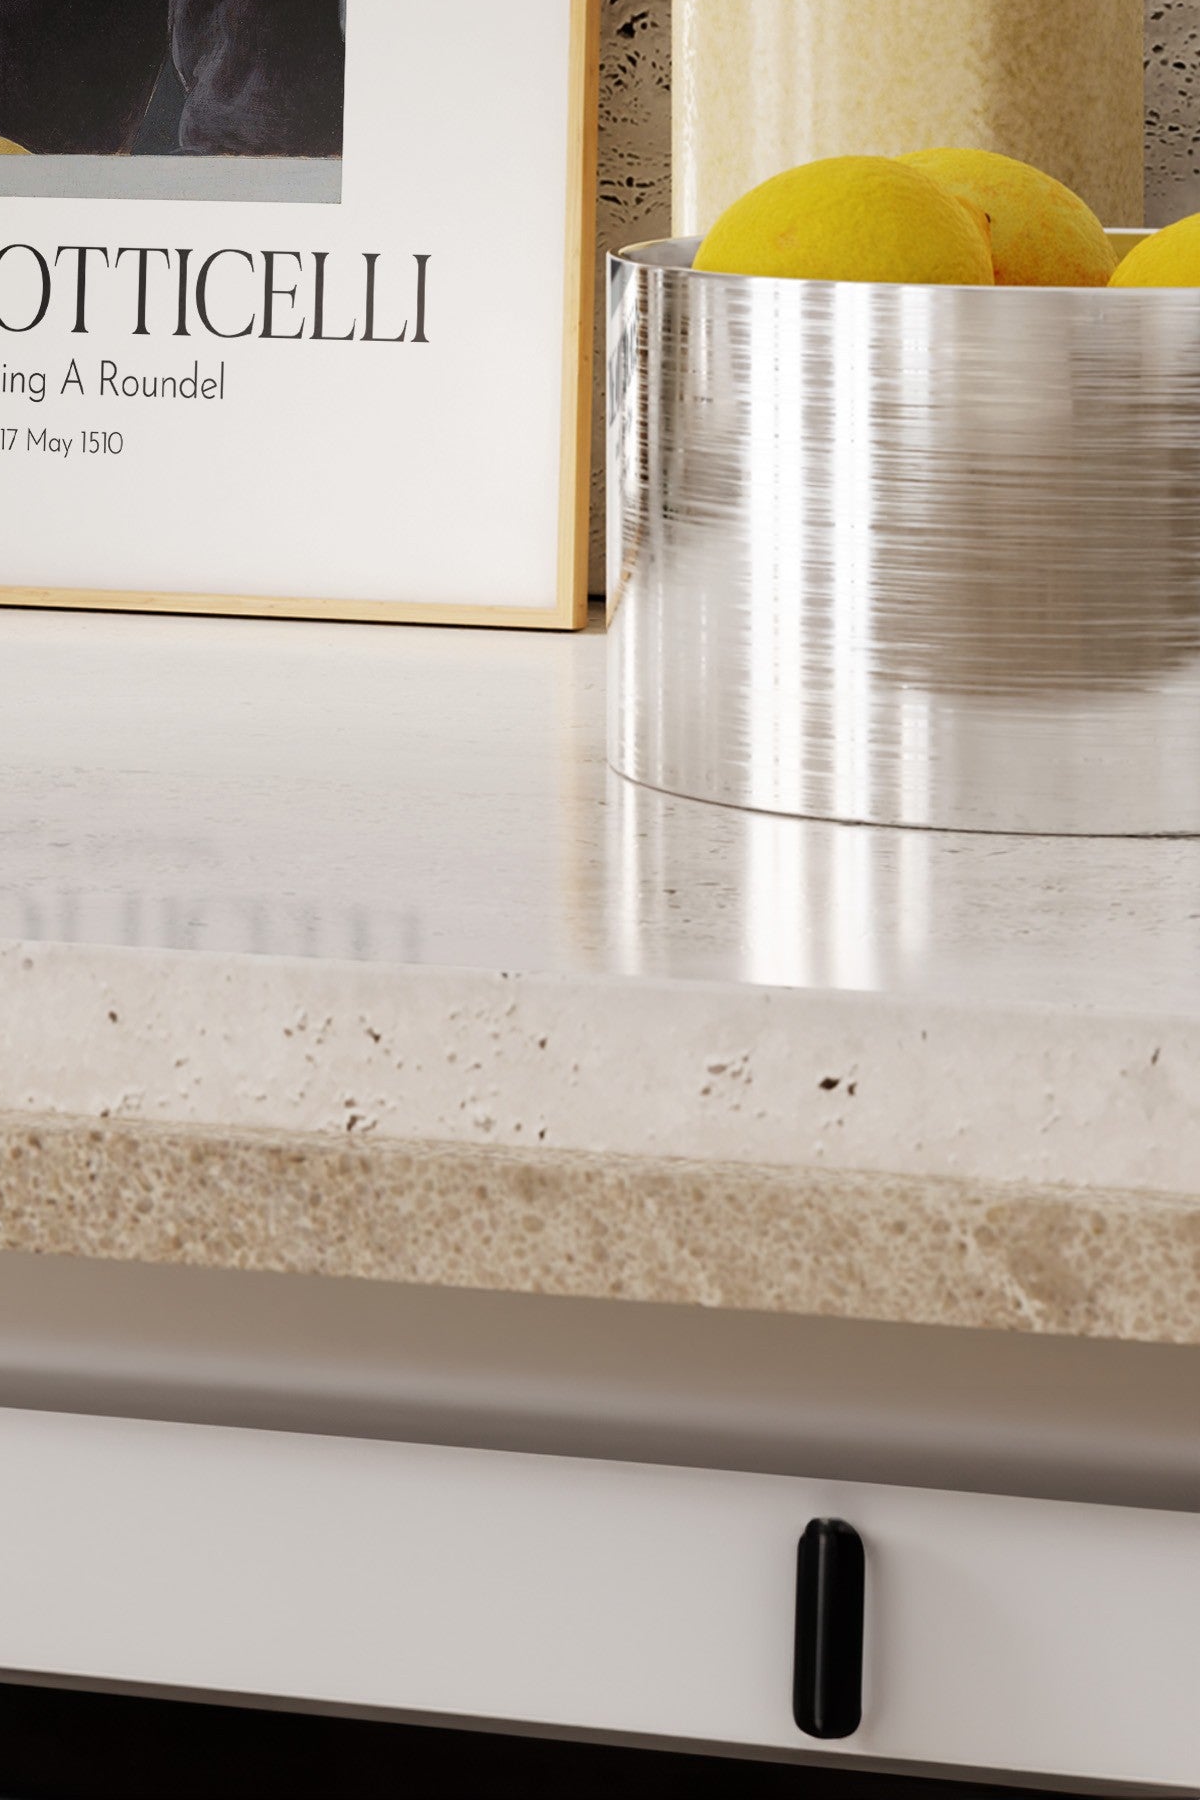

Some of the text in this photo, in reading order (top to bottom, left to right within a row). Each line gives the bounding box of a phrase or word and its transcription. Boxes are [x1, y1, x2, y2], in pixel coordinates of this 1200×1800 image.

[60, 358, 85, 396] A
[100, 360, 225, 400] Roundel
[0, 428, 19, 451] 17
[27, 427, 74, 458] May
[81, 431, 124, 455] 1510
